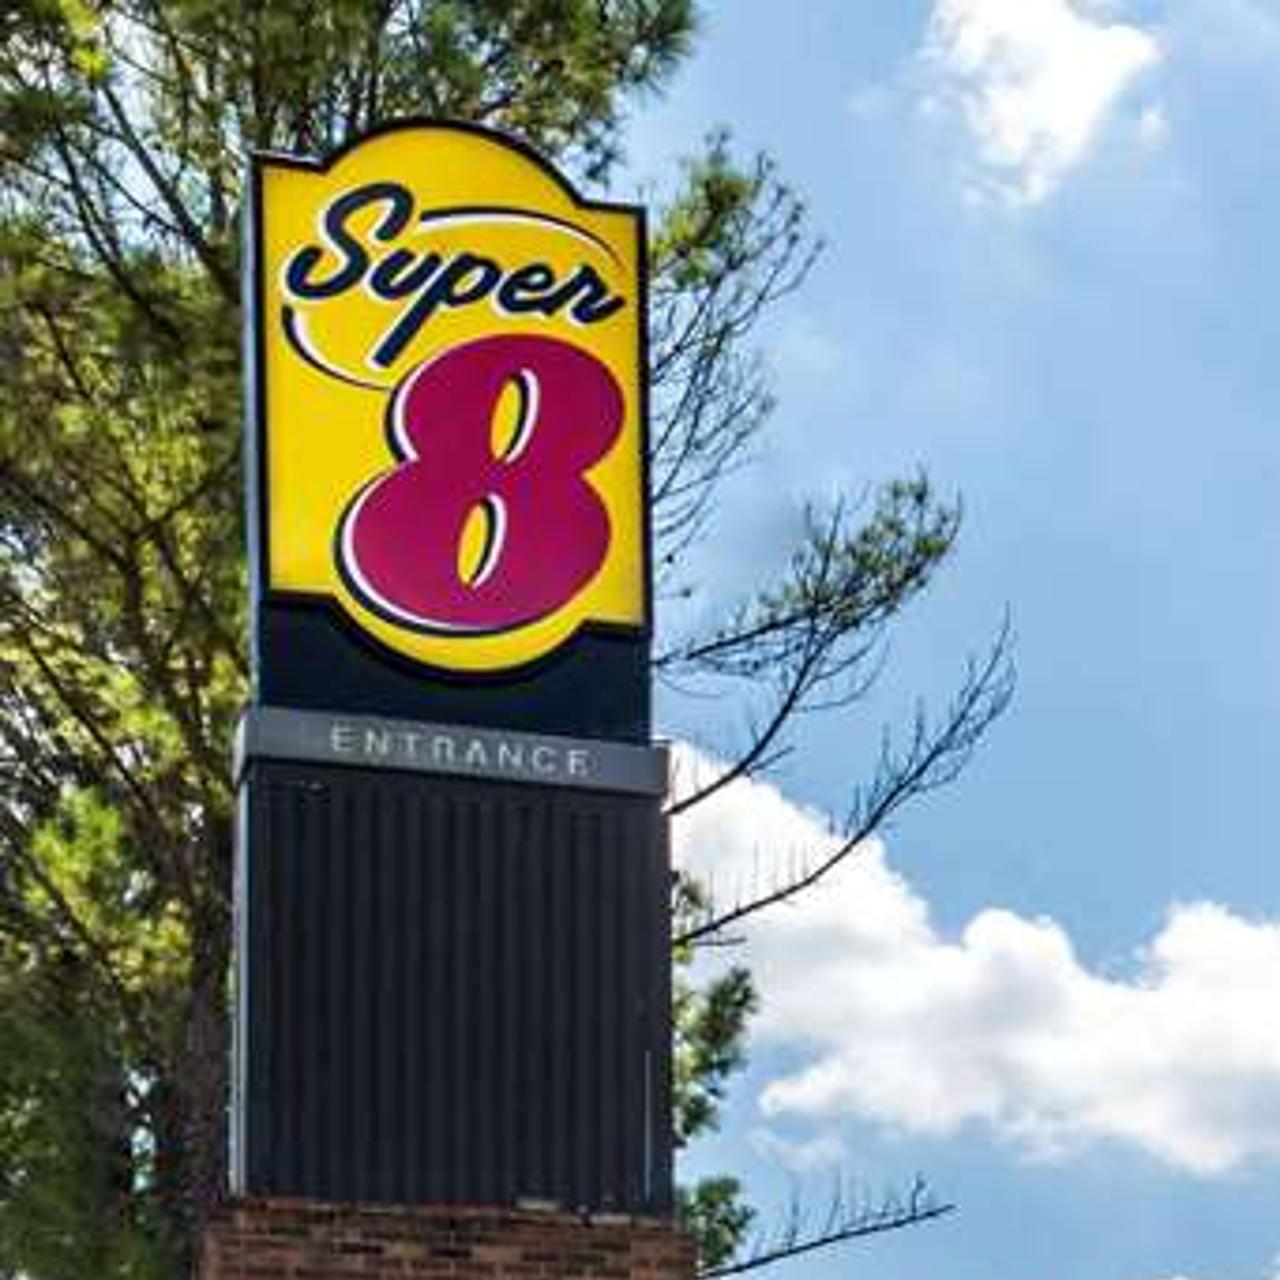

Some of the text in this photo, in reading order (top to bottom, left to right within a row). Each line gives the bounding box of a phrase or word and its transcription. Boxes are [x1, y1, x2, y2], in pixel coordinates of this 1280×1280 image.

[284, 182, 625, 368] Super
[334, 333, 626, 637] 8
[329, 721, 593, 777] ENTRANCE
